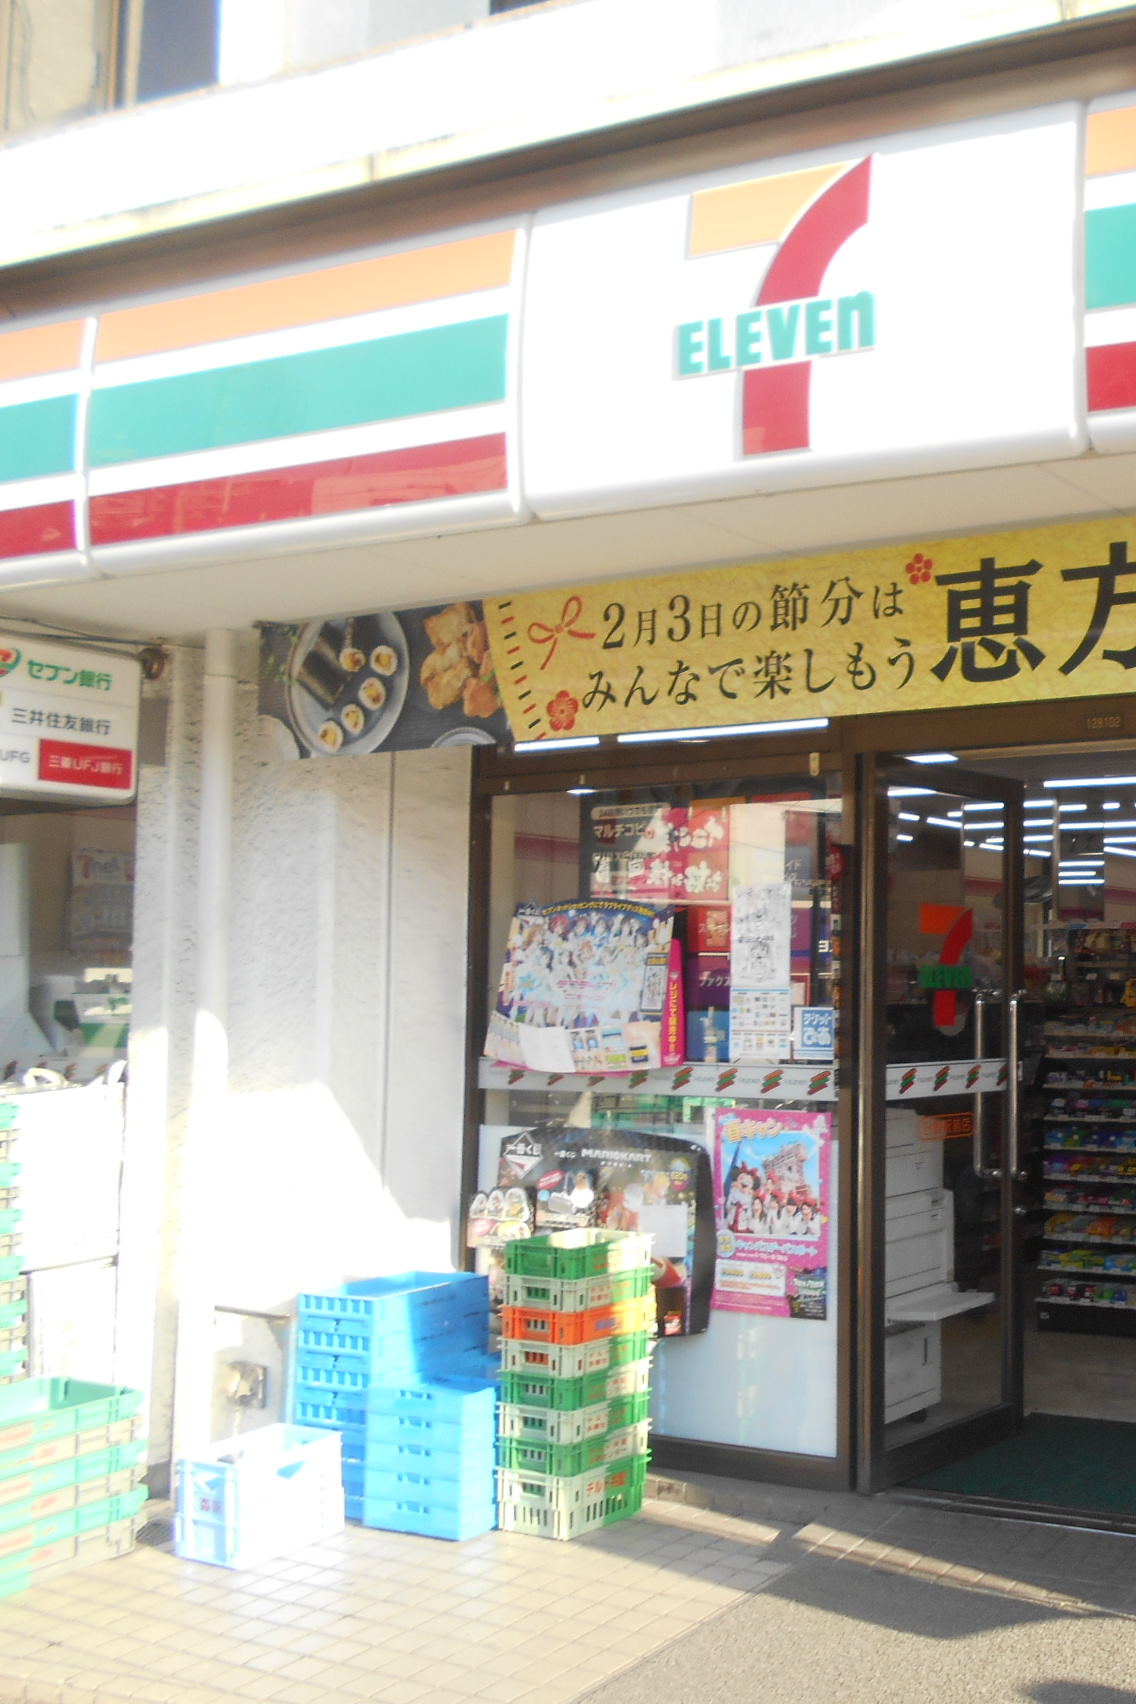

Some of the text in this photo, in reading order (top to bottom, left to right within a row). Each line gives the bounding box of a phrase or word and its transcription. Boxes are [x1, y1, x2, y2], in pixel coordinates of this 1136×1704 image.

[599, 576, 905, 651] 2月3日の節分は
[27, 660, 113, 691] セブン銀行
[580, 637, 915, 712] みんなで楽しもう
[12, 707, 111, 735] 三井住友銀行
[48, 754, 123, 775] 三菱UFJ銀行
